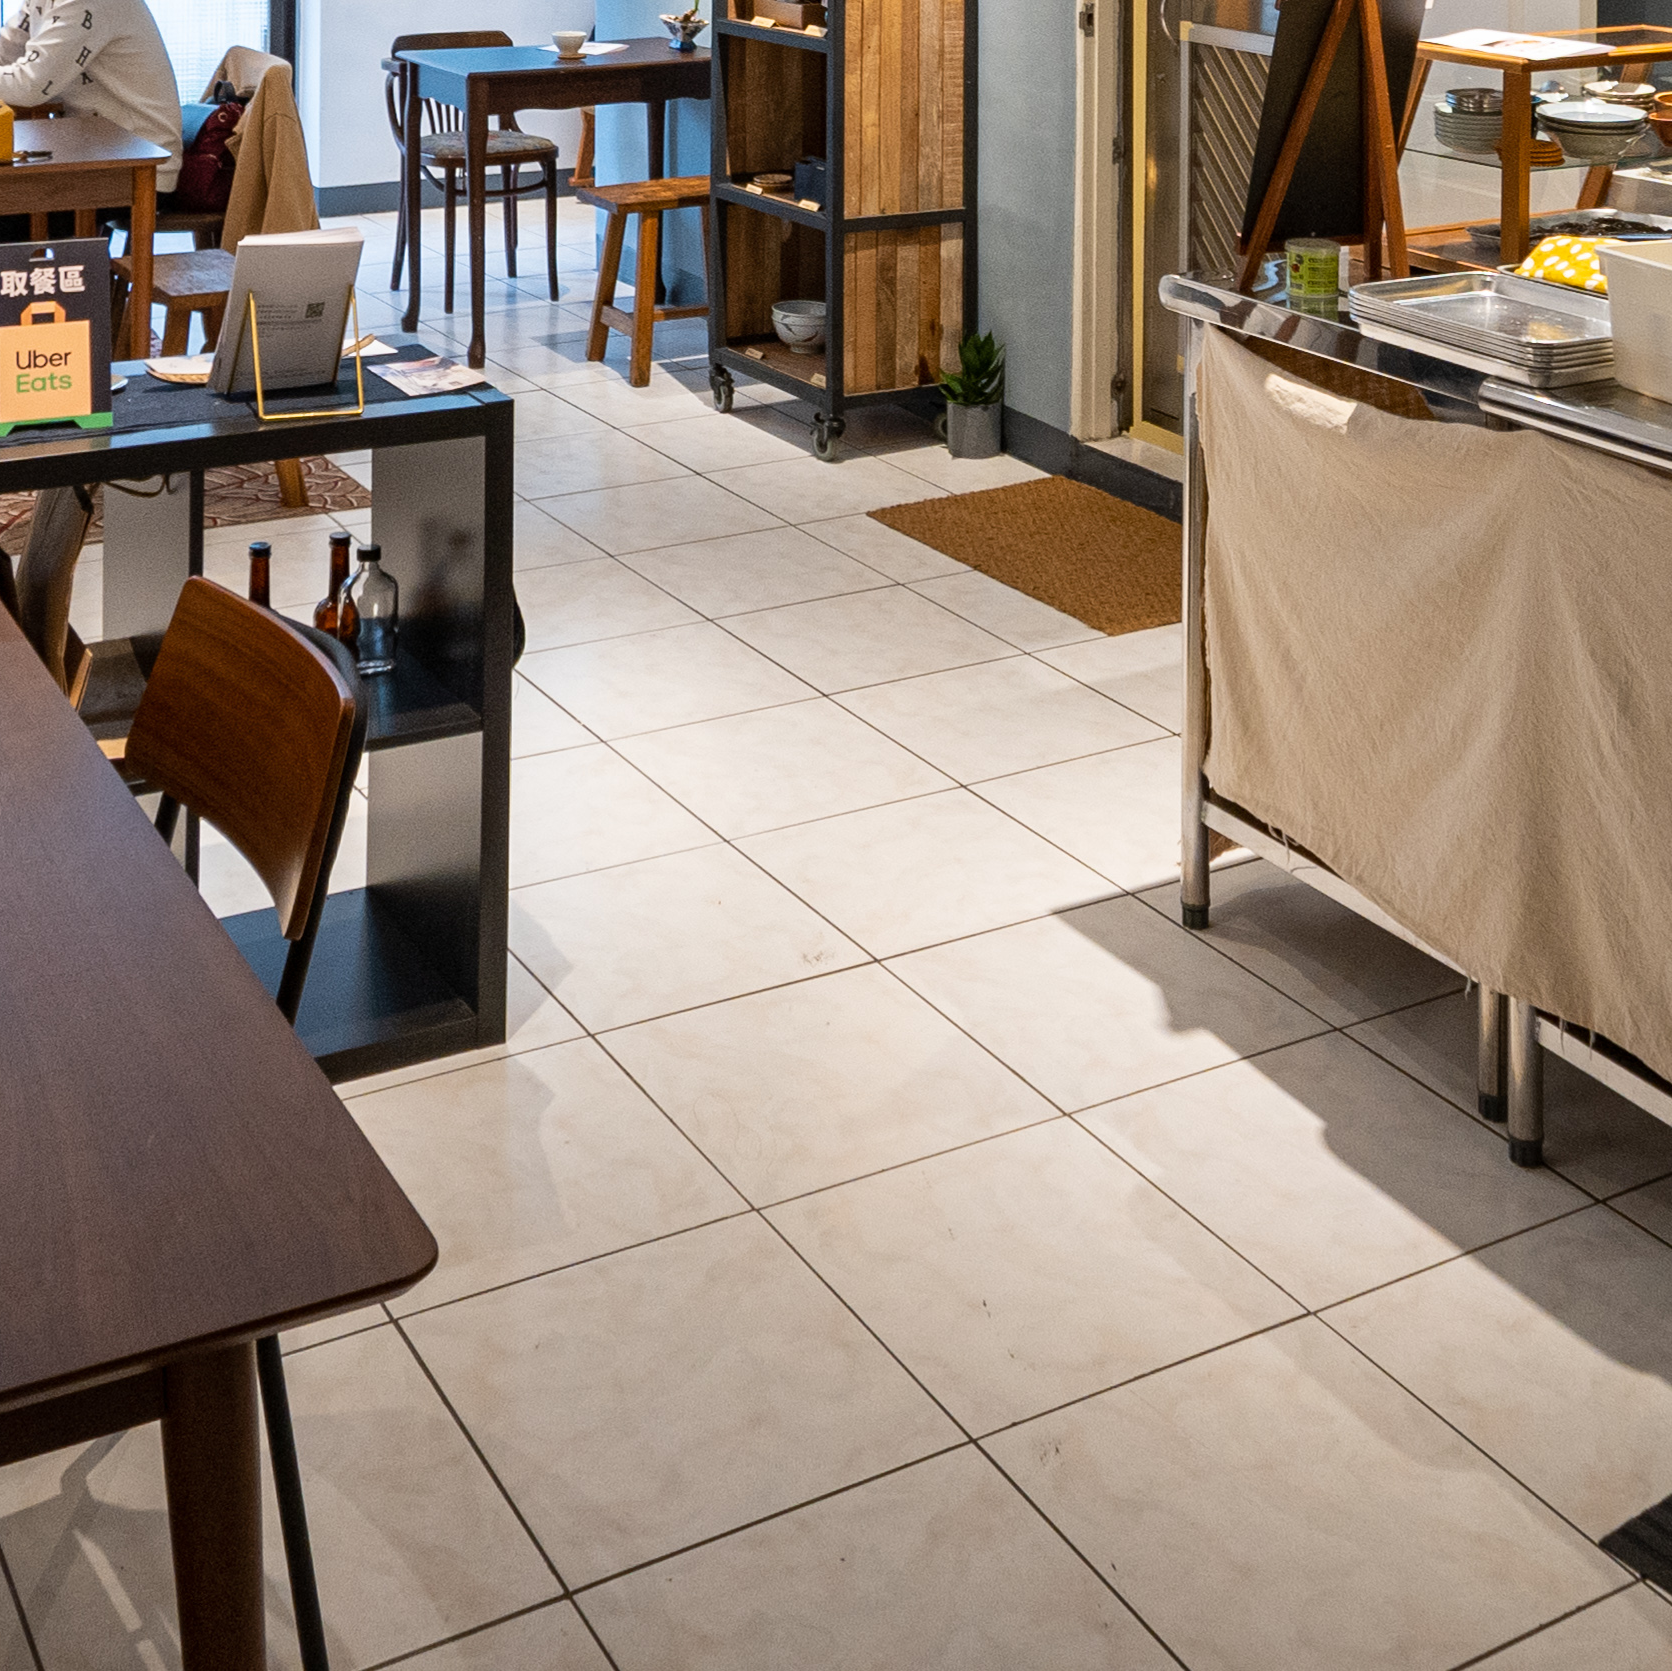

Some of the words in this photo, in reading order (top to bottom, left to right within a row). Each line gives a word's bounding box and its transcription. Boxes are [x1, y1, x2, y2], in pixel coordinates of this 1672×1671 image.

[0, 265, 85, 297] 取餐區
[16, 350, 71, 369] Uber
[16, 373, 72, 393] Eats
